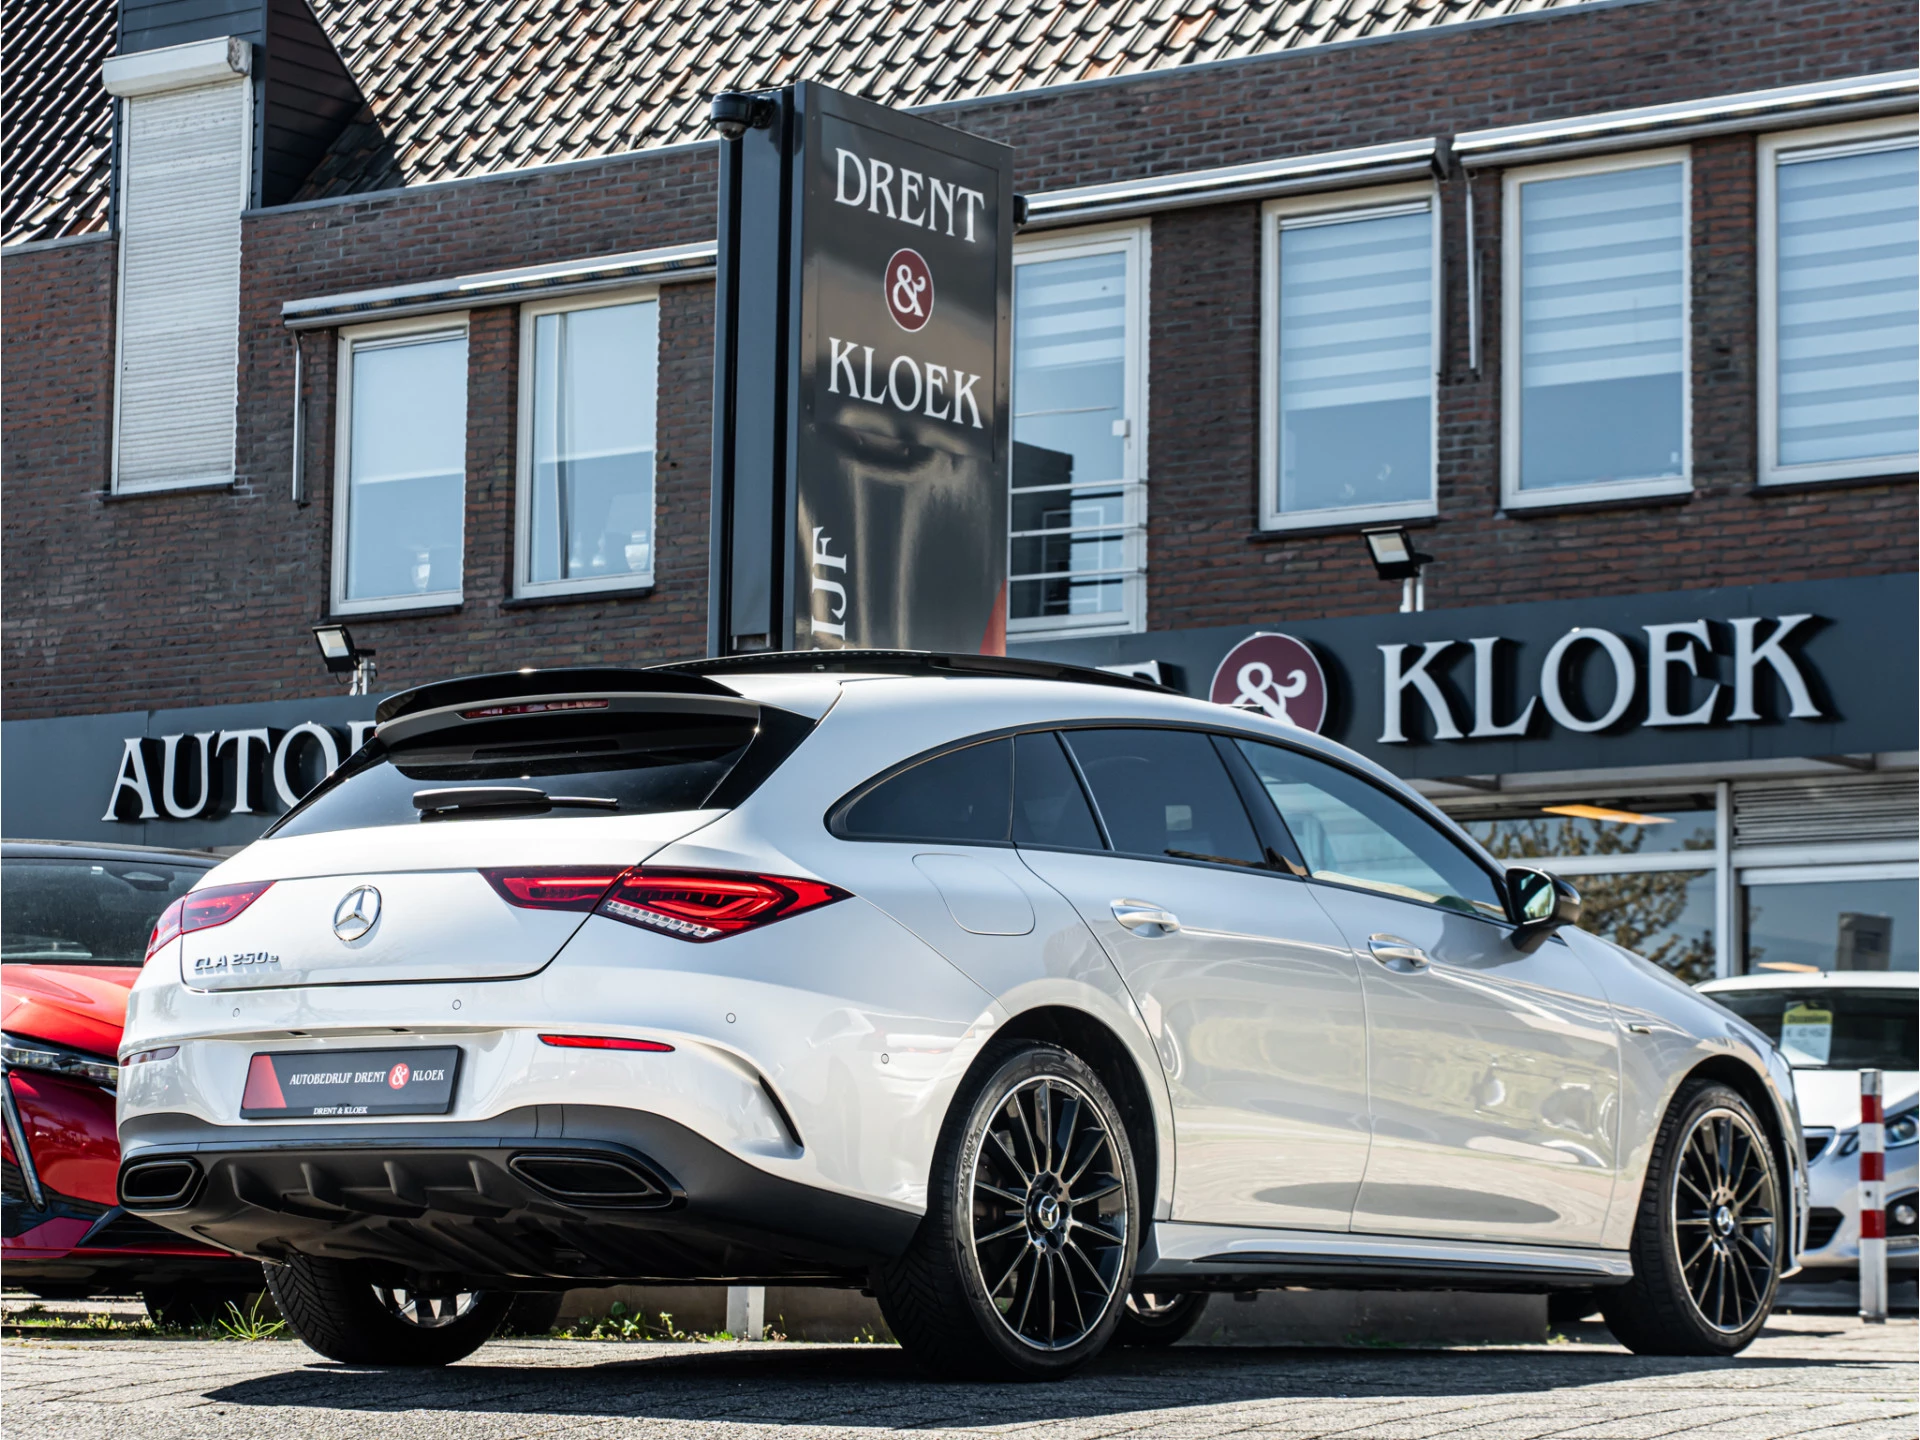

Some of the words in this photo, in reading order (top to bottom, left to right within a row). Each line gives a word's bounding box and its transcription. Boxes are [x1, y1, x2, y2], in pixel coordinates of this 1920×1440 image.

[834, 147, 985, 243] DRENT
[892, 263, 927, 318] &
[828, 336, 984, 430] KLOEK
[811, 526, 847, 650] IJF
[1231, 661, 1308, 726] &
[1376, 613, 1823, 744] KLOEK
[194, 955, 228, 971] CLA
[230, 951, 280, 966] 250e
[289, 1072, 352, 1085] AUTOBEDRIJF
[354, 1071, 387, 1084] DRENT
[391, 1065, 409, 1086] &
[412, 1069, 445, 1082] KLOEK
[313, 1107, 336, 1115] DRENT
[336, 1106, 343, 1115] &
[344, 1106, 368, 1114] KLOEK
